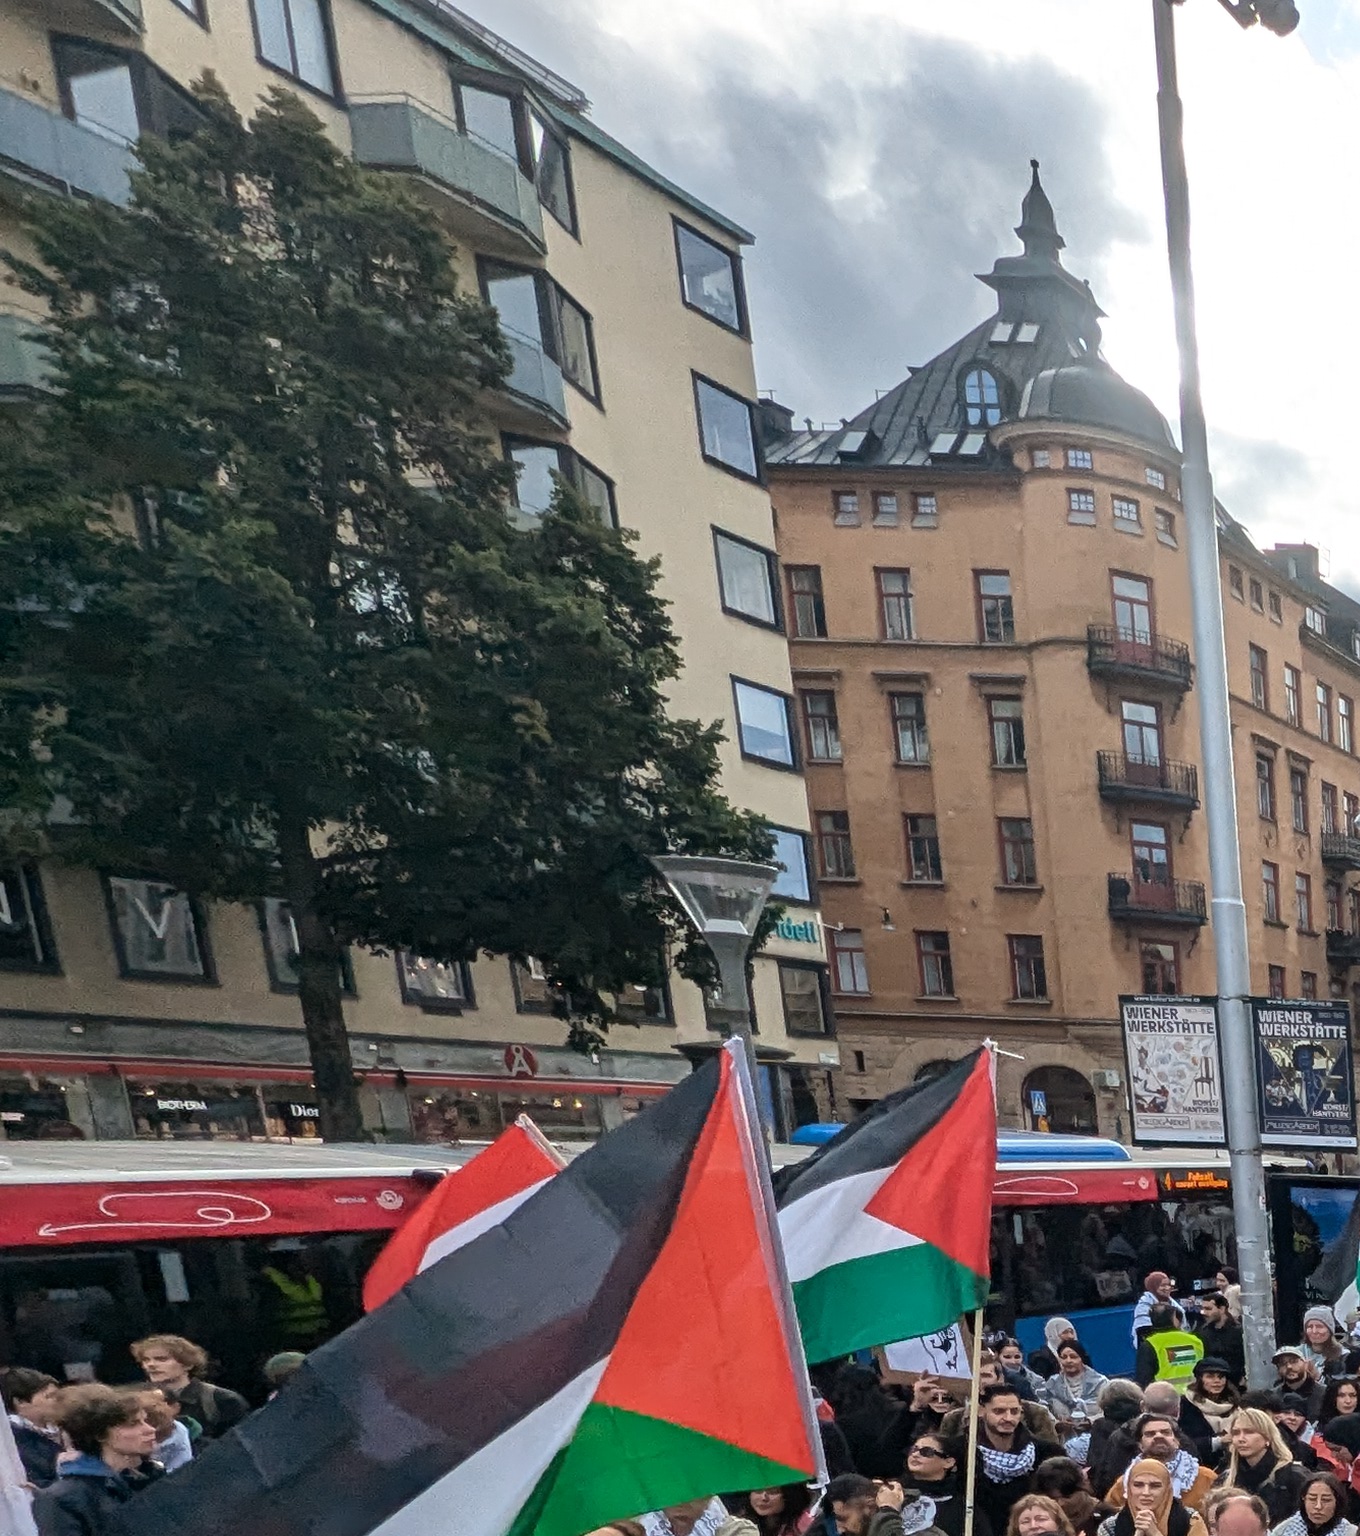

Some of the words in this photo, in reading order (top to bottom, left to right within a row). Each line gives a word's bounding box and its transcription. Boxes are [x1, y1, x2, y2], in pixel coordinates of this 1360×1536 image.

[1125, 1006, 1178, 1020] WIENER
[1258, 1009, 1312, 1024] WIENER
[1127, 1018, 1214, 1034] WERKSTÄTTE
[1259, 1022, 1347, 1038] WERKSTÄTTE
